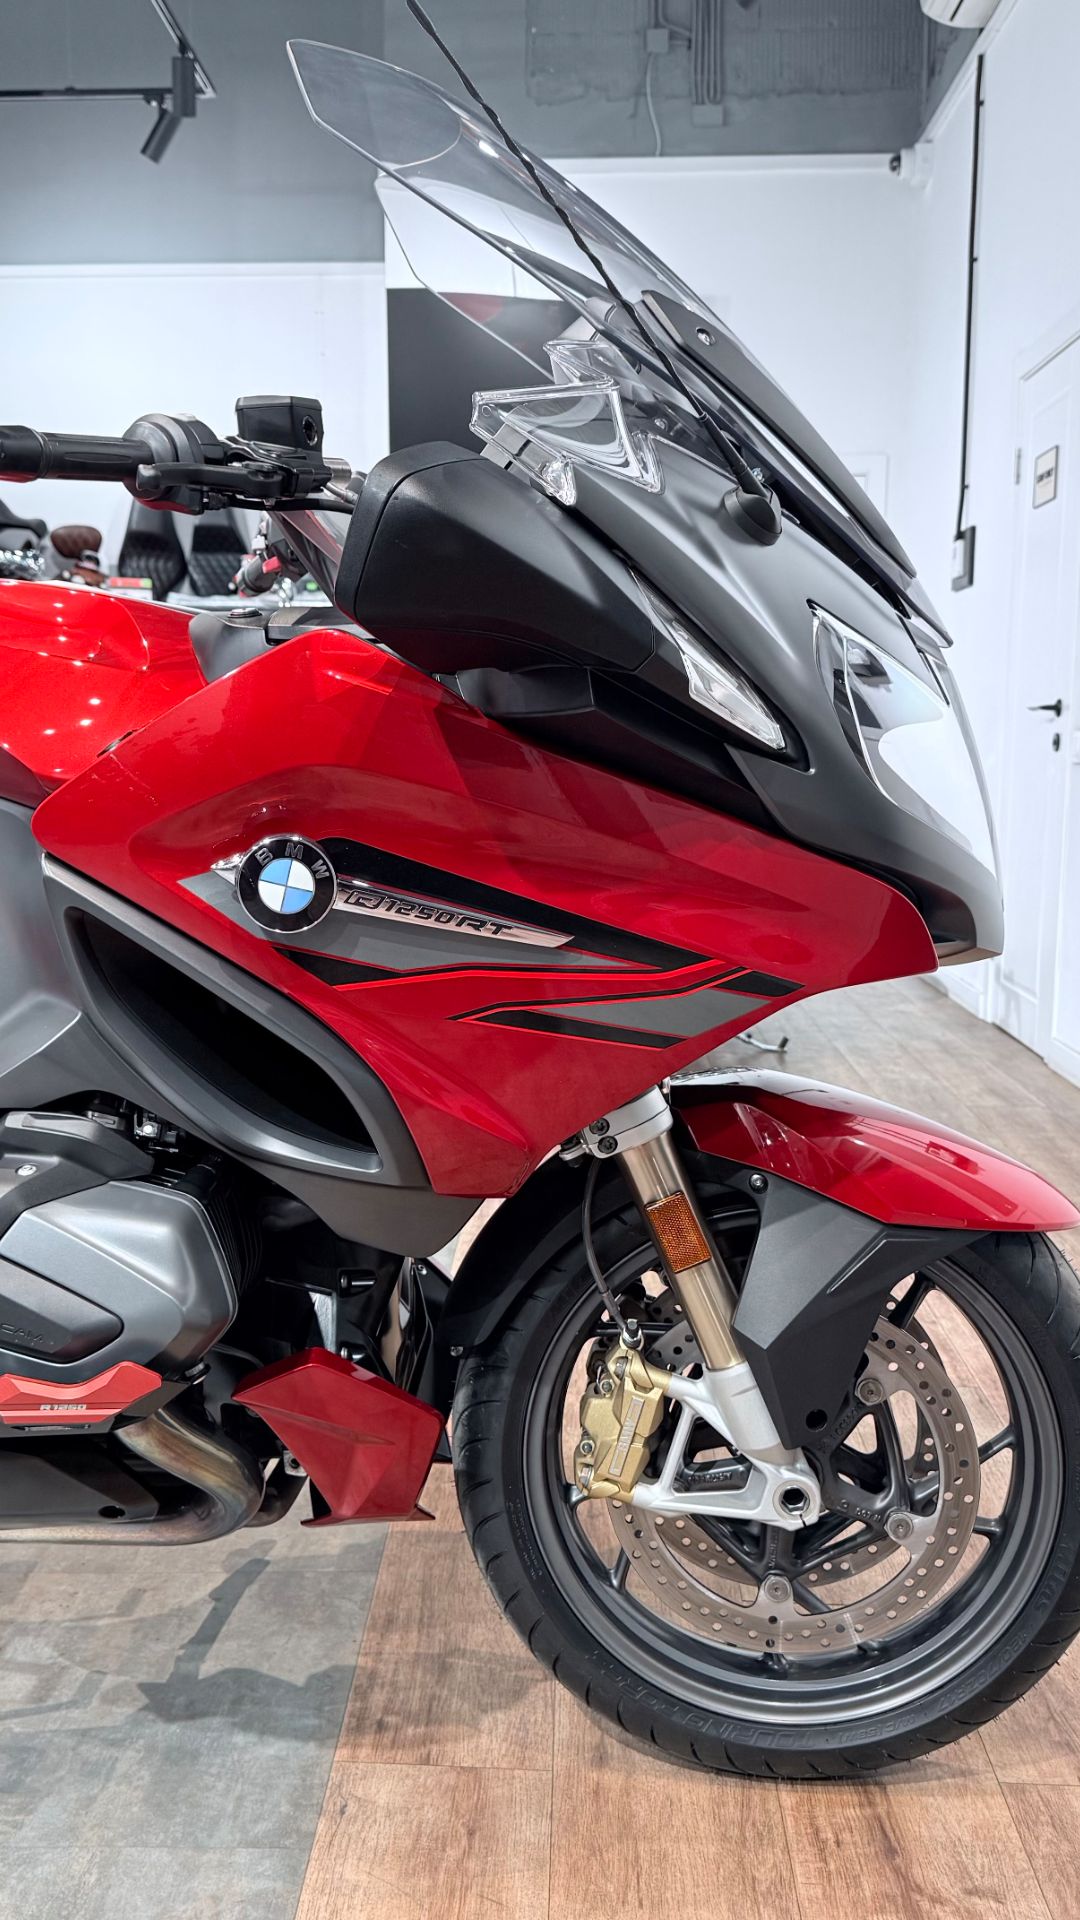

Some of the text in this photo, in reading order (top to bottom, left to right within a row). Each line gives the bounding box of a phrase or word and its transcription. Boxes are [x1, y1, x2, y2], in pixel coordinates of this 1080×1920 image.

[255, 842, 330, 879] BMW
[344, 889, 513, 935] R1250RT
[683, 1712, 815, 1749] TOURING
